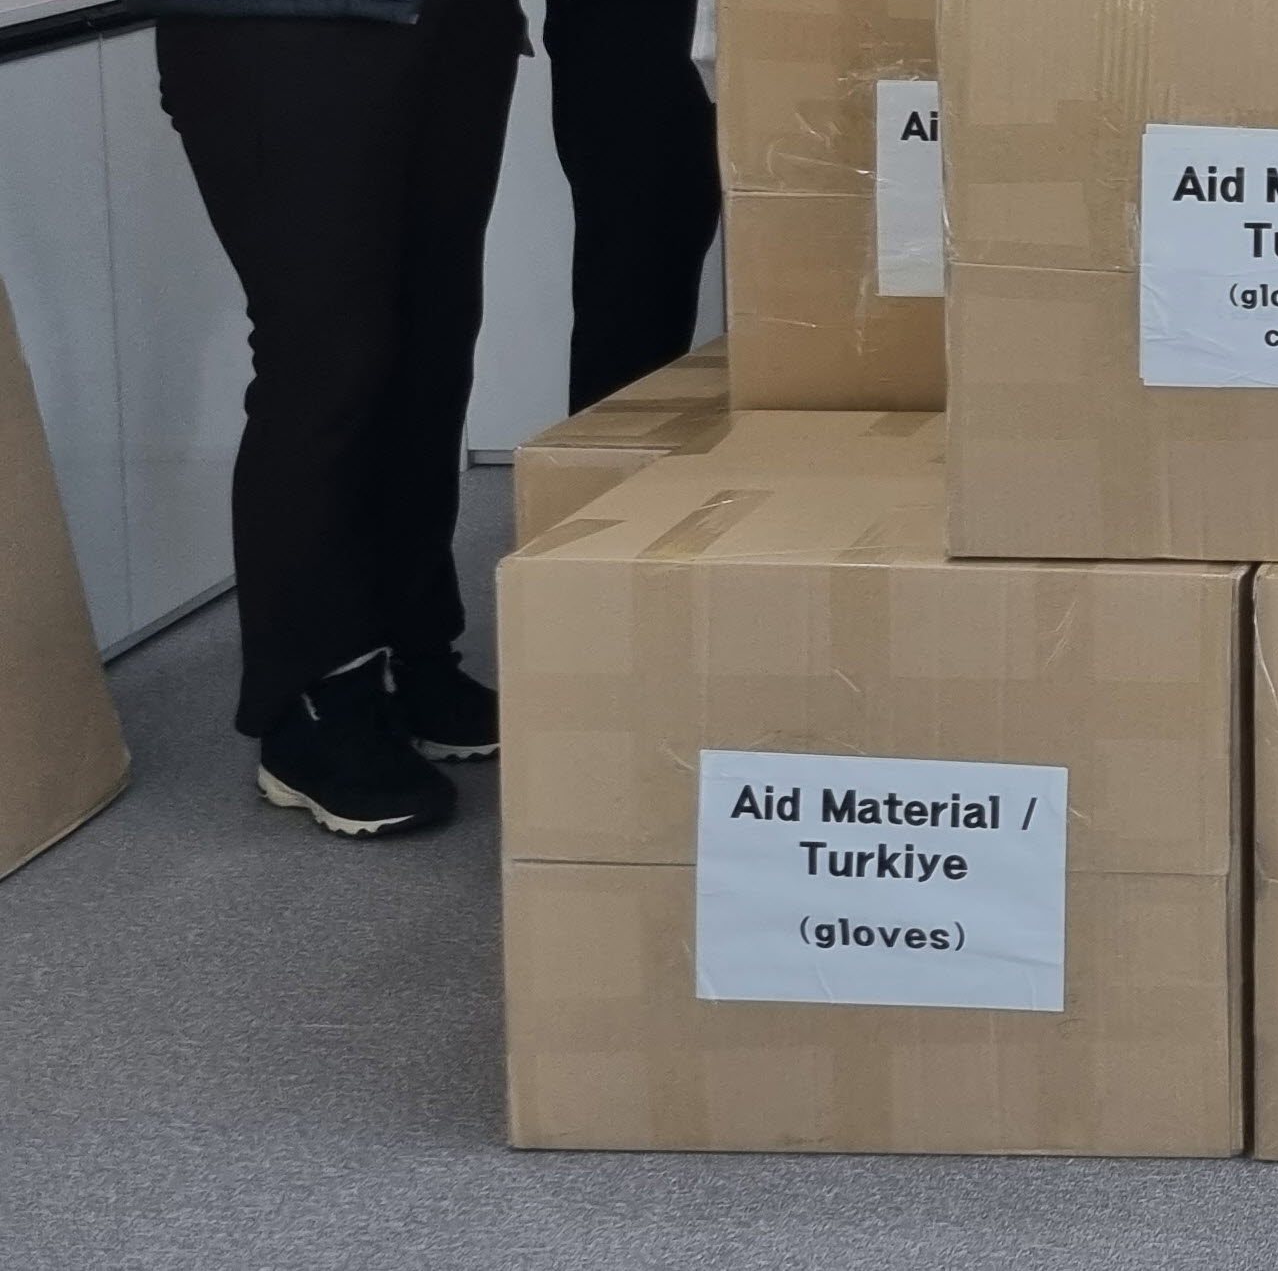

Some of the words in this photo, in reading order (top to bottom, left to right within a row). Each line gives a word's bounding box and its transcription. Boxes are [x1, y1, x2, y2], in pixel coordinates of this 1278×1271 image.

[1172, 165, 1245, 203] Aid
[730, 784, 801, 822] Aid
[821, 788, 1000, 830] Material
[1021, 797, 1038, 831] /
[798, 841, 969, 883] Turkiye
[799, 915, 965, 952] (gloves)
